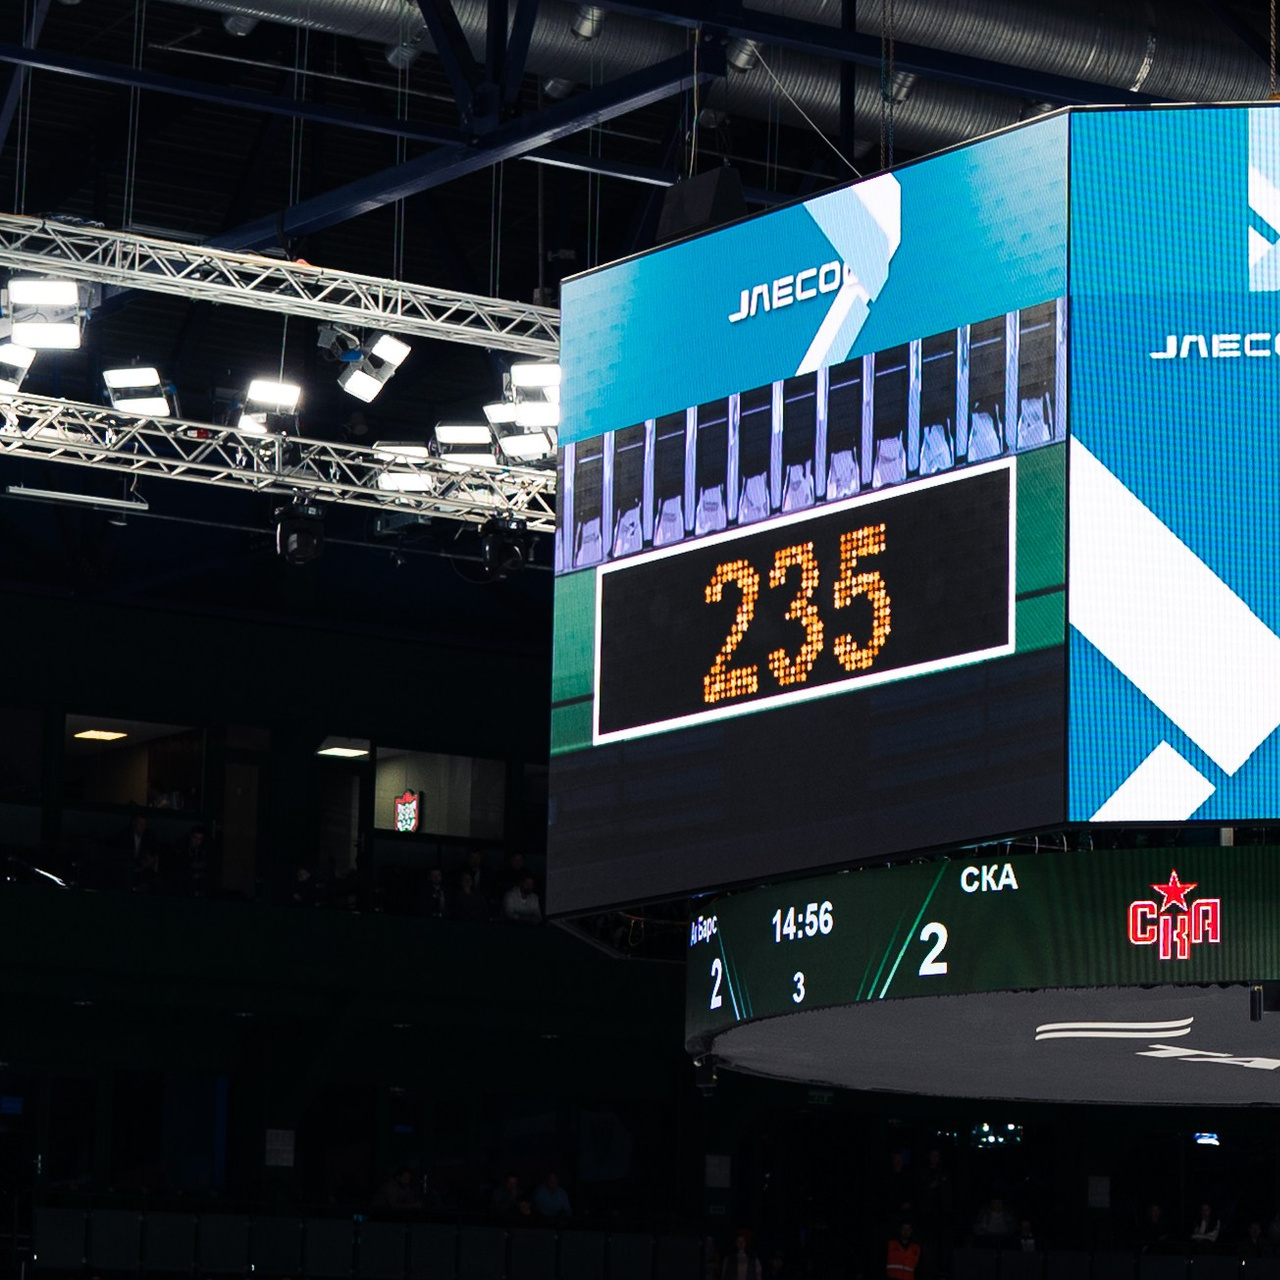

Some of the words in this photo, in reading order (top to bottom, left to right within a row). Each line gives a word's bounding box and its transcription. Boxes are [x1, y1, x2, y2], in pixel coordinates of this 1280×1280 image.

[702, 521, 892, 704] 235
[960, 862, 1019, 894] СКА
[698, 915, 718, 943] Барс
[771, 900, 834, 943] 14:56
[1127, 897, 1222, 960] СКА
[917, 921, 949, 976] 2
[710, 957, 723, 1010] 2
[792, 970, 806, 1004] 3
